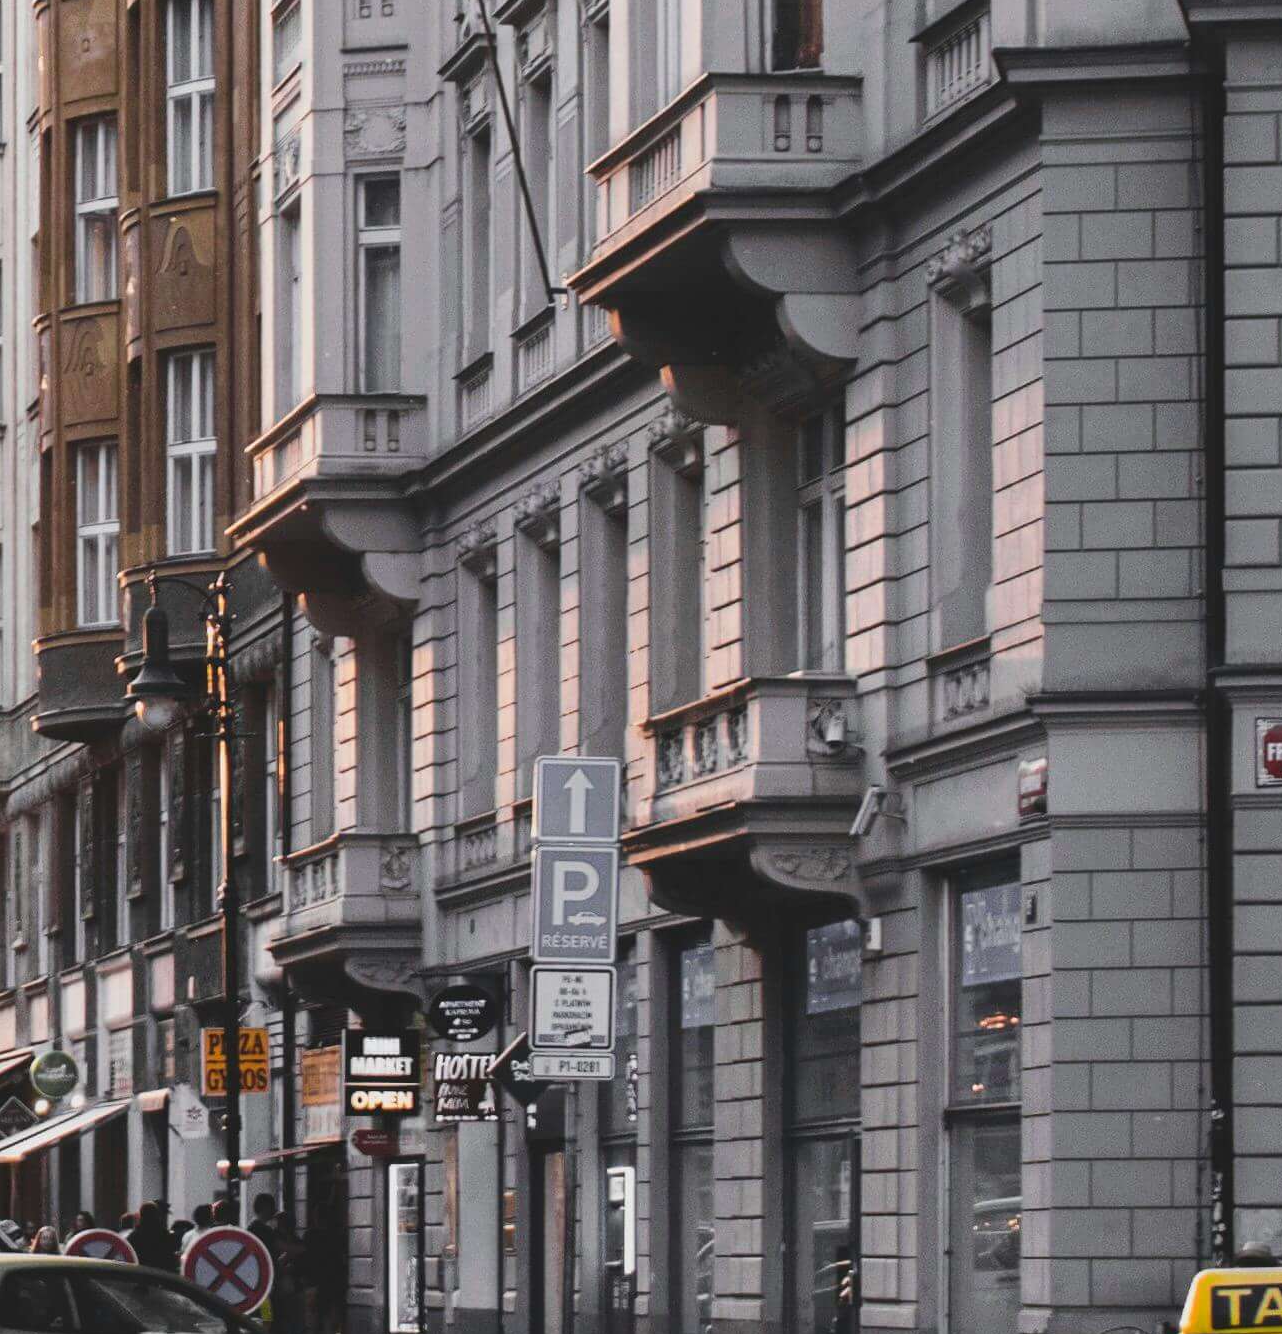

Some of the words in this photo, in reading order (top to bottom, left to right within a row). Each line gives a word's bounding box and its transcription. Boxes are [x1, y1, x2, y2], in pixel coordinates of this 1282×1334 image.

[552, 860, 599, 925] P
[208, 1032, 265, 1055] PIZA
[350, 1056, 413, 1076] MARKET
[350, 1090, 414, 1112] OPEN
